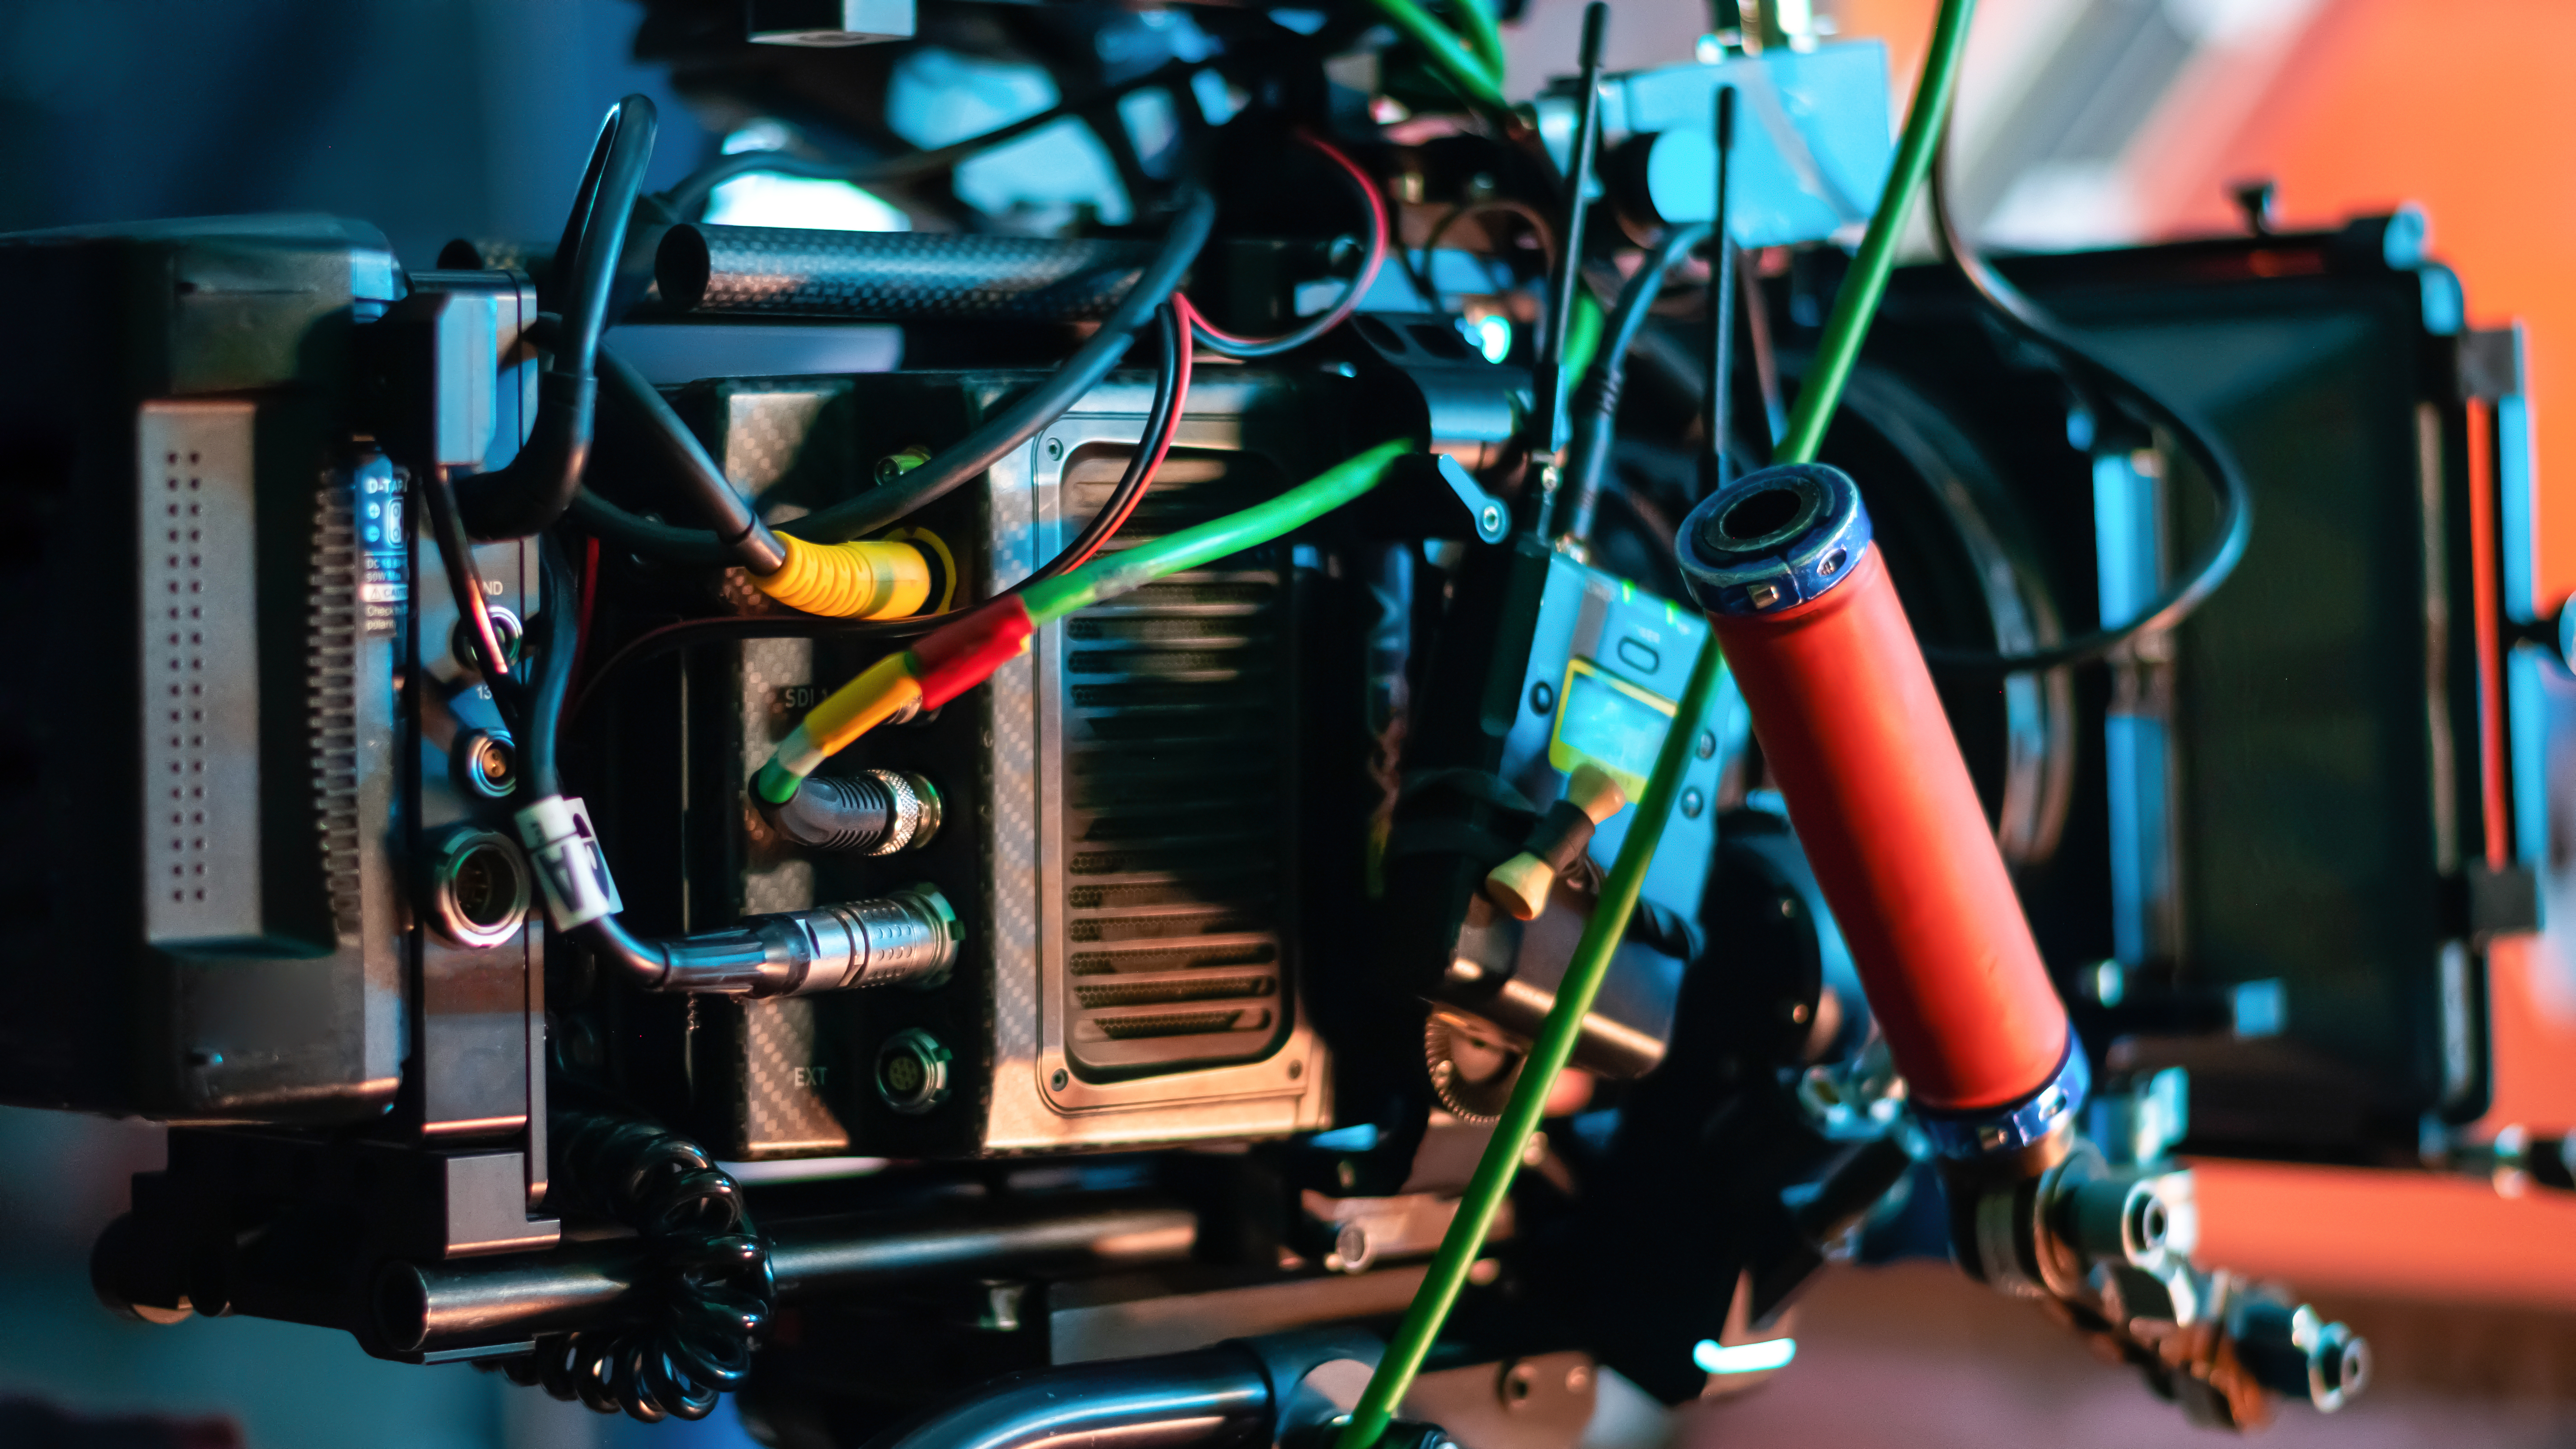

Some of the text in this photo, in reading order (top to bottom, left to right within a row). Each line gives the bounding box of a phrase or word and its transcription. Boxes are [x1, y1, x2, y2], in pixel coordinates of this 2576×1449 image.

[366, 478, 403, 494] D-TAP
[786, 688, 814, 708] SDI
[794, 1067, 828, 1086] EXT
